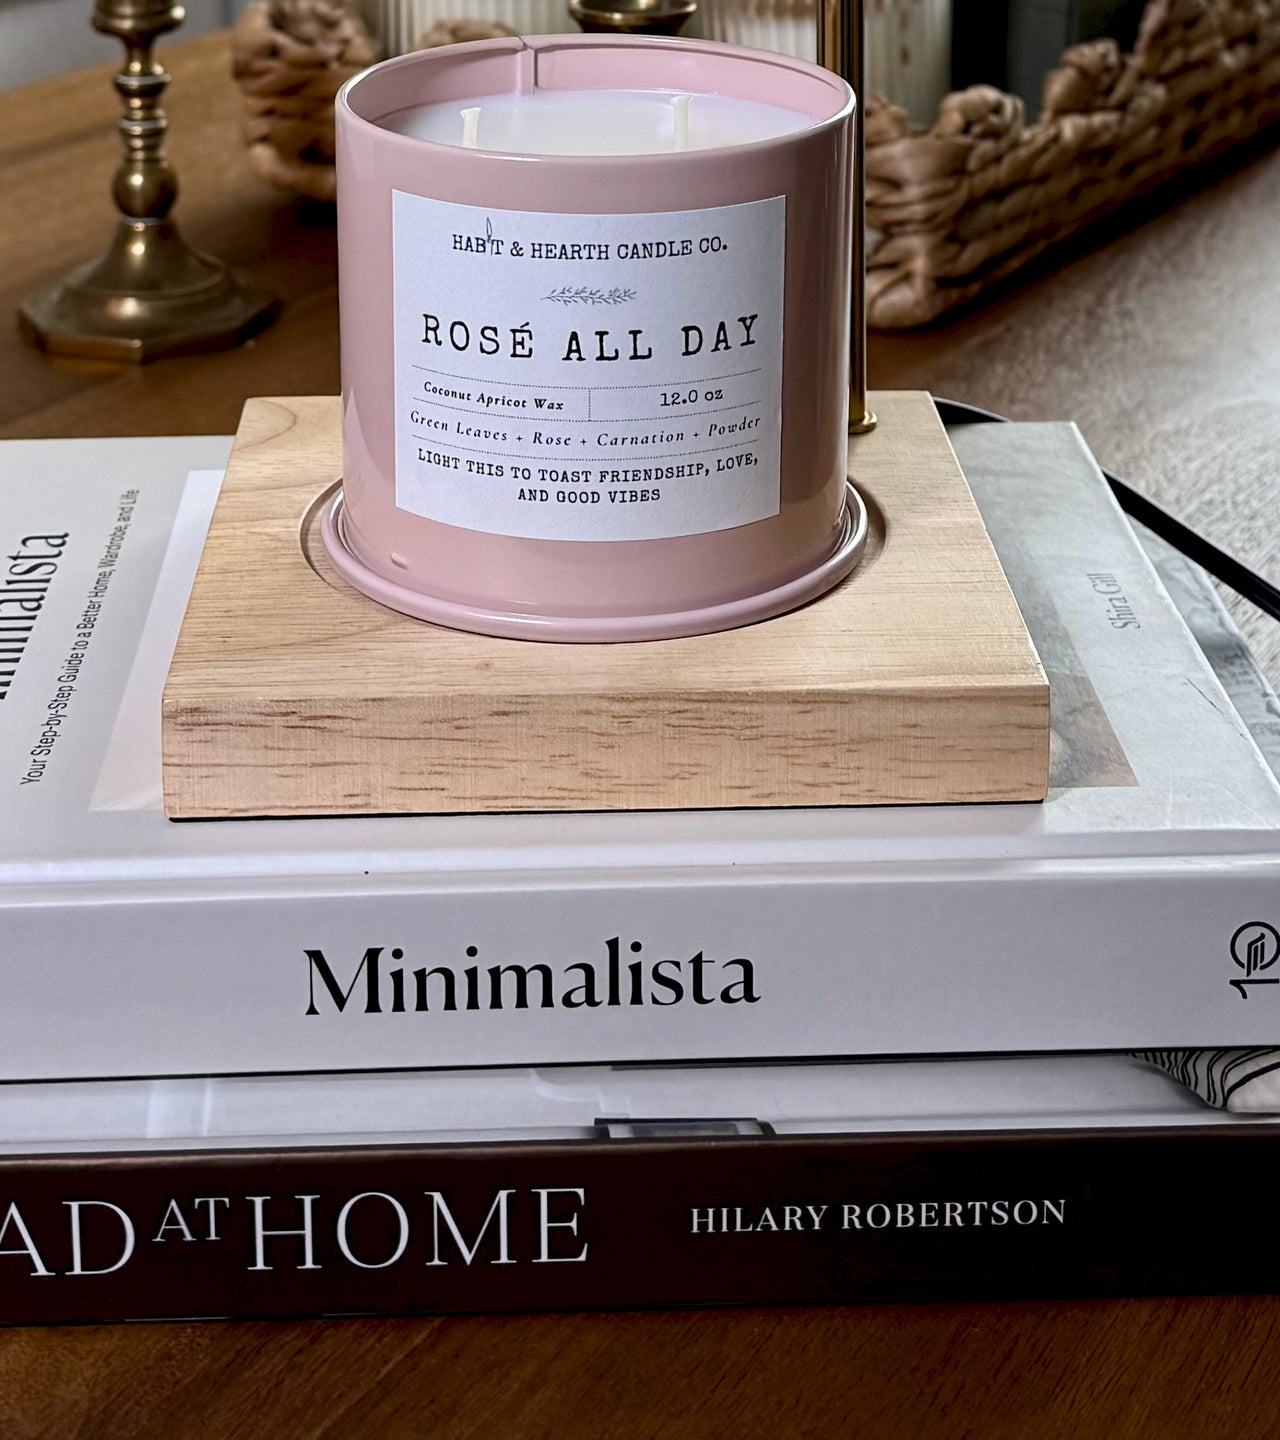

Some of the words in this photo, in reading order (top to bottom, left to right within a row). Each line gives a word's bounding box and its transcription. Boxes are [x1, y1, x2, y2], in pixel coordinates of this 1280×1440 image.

[510, 241, 524, 258] &
[531, 242, 610, 260] HEARTH
[616, 240, 693, 260] CANDLE
[699, 236, 728, 254] CO.
[422, 314, 533, 359] ROSÉ
[562, 329, 653, 361] ALL
[681, 313, 759, 357] DAY
[423, 381, 472, 401] Coconut
[476, 392, 527, 408] Apricot
[534, 398, 564, 411] Wax
[660, 389, 698, 407] 12.0
[704, 389, 724, 402] oz
[410, 410, 449, 431] Green
[456, 421, 508, 442] Leaves
[532, 431, 571, 446] Rose
[597, 430, 685, 447] Carnation
[708, 415, 761, 437] Powder
[418, 447, 461, 470] LIGHT
[466, 460, 504, 477] THIS
[510, 466, 531, 481] TO
[538, 469, 592, 483] TOAST
[599, 463, 711, 483] FRIENDSHIP,
[716, 452, 759, 473] LOVE,
[518, 488, 549, 502] AND
[556, 491, 601, 504] GOOD
[608, 489, 661, 504] VIBES
[118, 506, 135, 522] and
[87, 569, 117, 598] Home,
[1086, 572, 1122, 595] Gill
[76, 599, 103, 630] Better
[1106, 596, 1141, 629] Shira
[71, 640, 89, 651] to
[57, 652, 85, 683] Guide
[30, 685, 78, 756] Step-by-Step
[20, 759, 48, 786] Your
[303, 936, 762, 1016] Minimalista
[151, 1196, 232, 1244] AT
[244, 1187, 589, 1271] HOME
[690, 1204, 829, 1234] HILARY
[840, 1197, 1067, 1230] ROBERTSON
